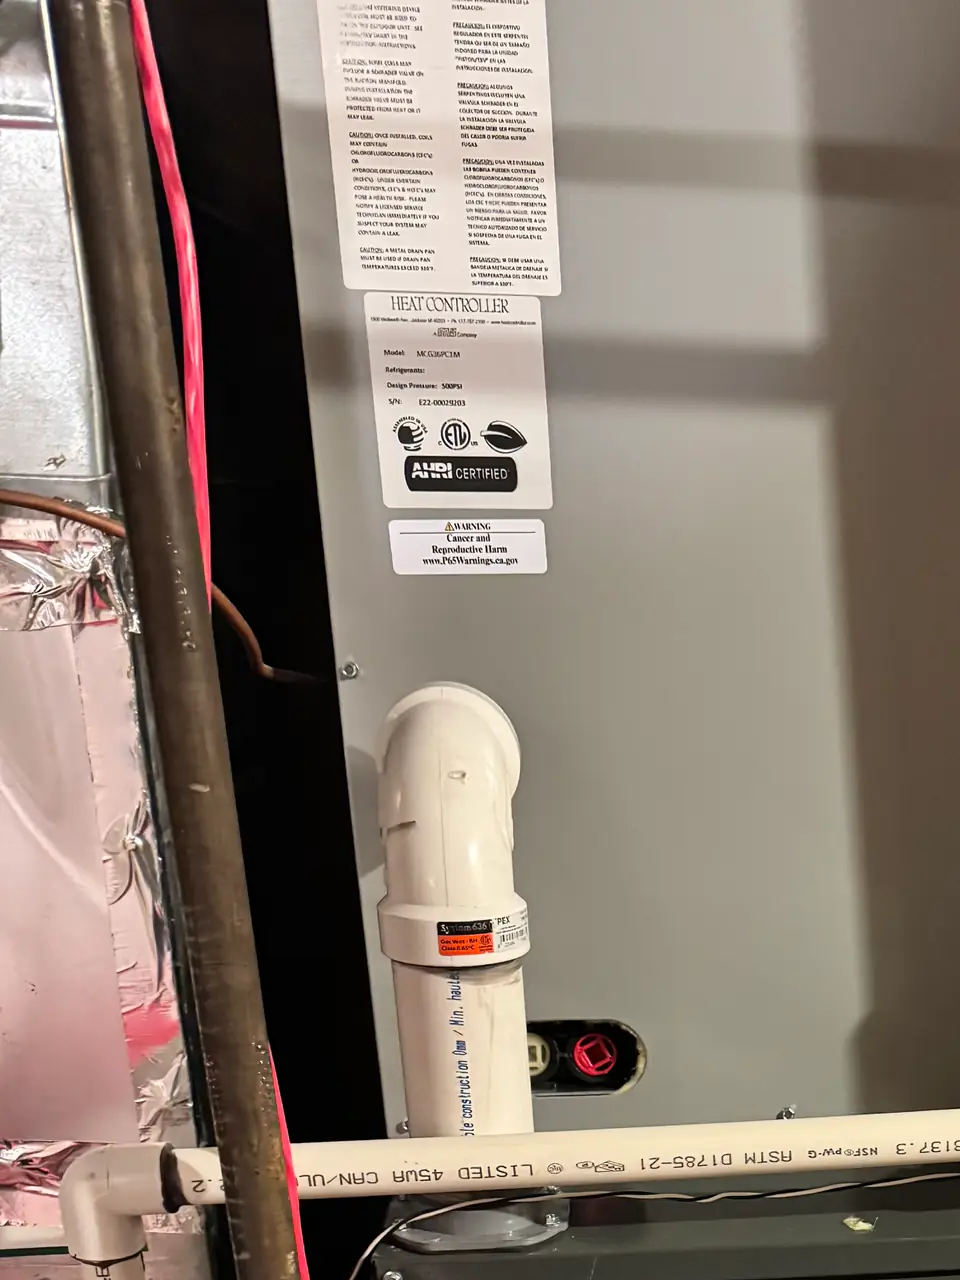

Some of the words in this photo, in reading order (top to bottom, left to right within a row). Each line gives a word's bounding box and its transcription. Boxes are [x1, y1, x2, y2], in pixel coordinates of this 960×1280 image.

[391, 296, 422, 311] HEAT
[425, 296, 509, 314] CONTROLLER
[411, 462, 453, 479] AHRI
[454, 523, 491, 531] WARNING
[446, 534, 474, 542] Cancer
[475, 534, 490, 542] and
[431, 545, 483, 555] Reproductive
[485, 545, 508, 554] Harm
[422, 557, 519, 566] www.P65Warnings.ca.gov
[449, 1007, 464, 1026] Min.
[456, 1060, 474, 1119] construction
[641, 1153, 732, 1170] D1785-21
[744, 1149, 793, 1165] ASTM
[392, 1168, 444, 1182] 45WA
[458, 1163, 534, 1180] LISTED
